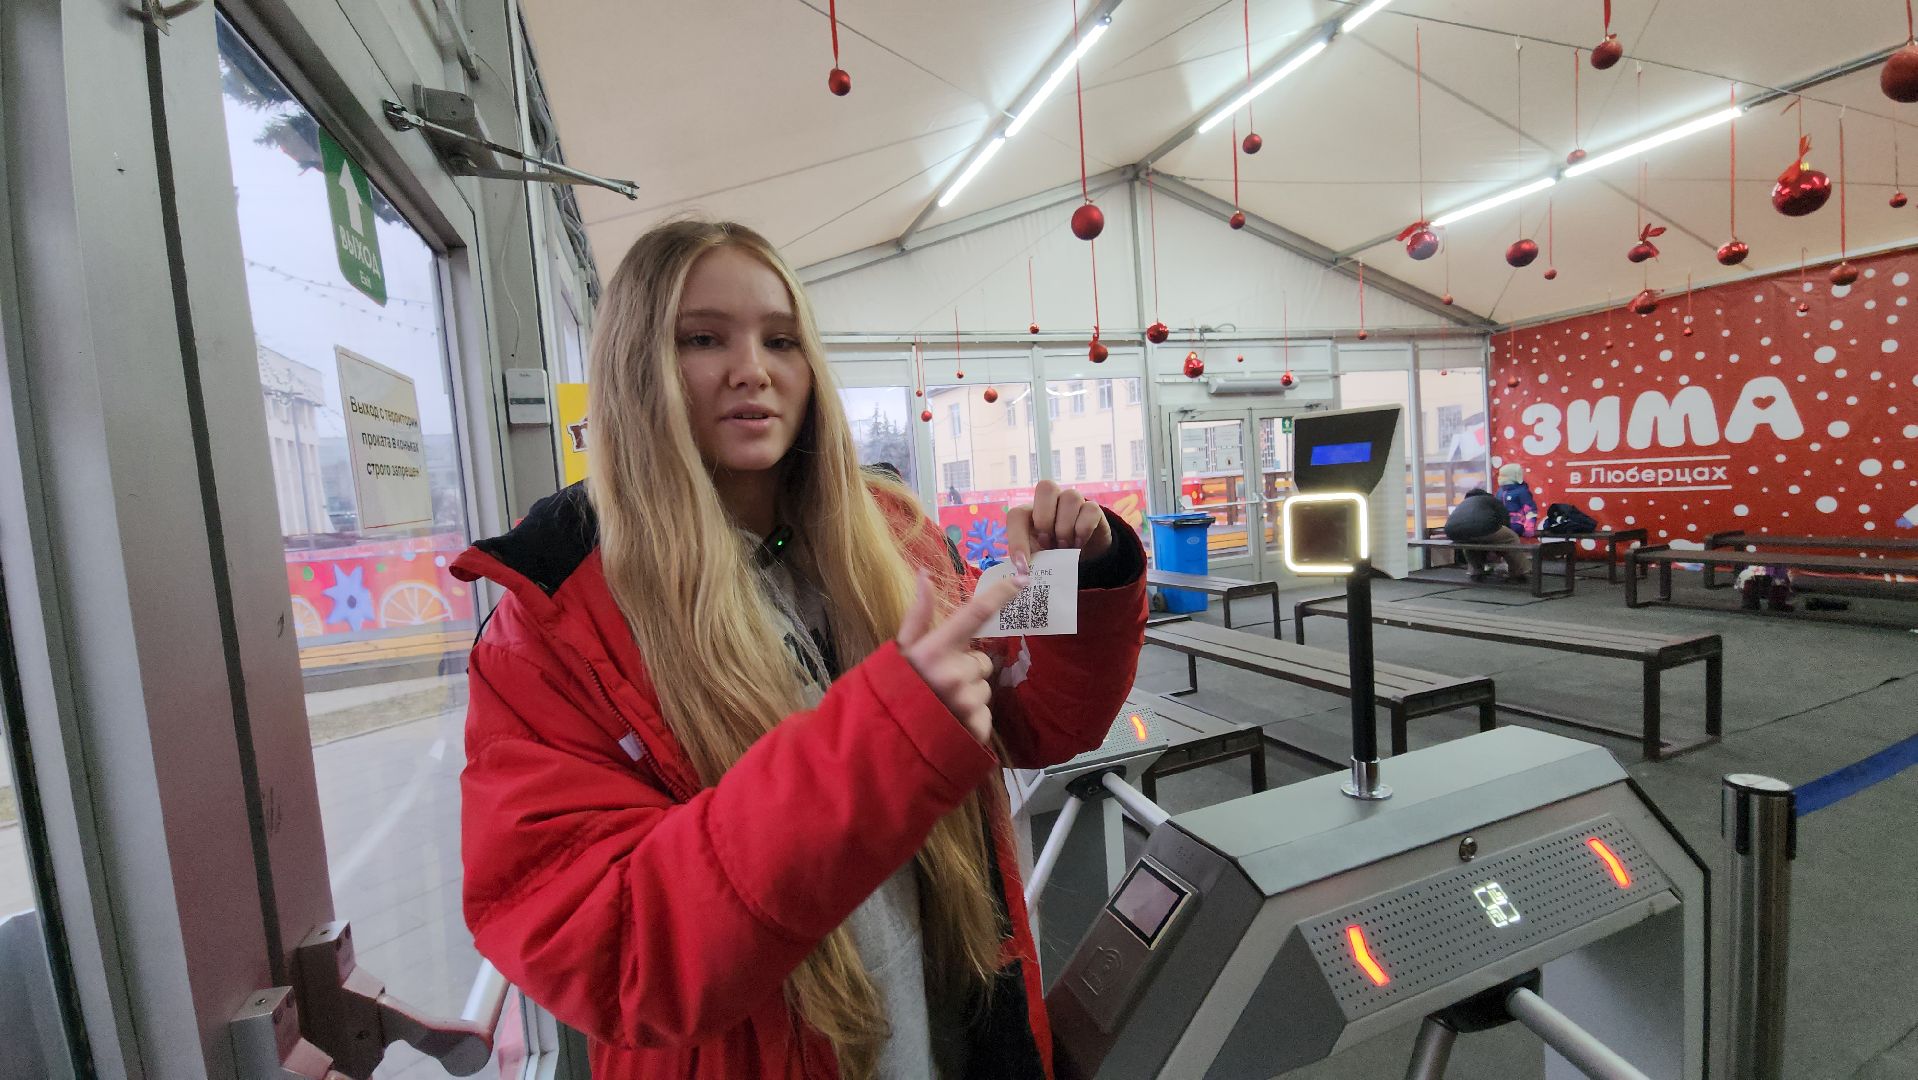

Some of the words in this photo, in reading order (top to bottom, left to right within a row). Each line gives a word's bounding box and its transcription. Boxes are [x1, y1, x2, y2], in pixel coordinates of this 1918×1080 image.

[339, 224, 381, 279] ВЫХОД
[350, 395, 379, 421] Выход
[384, 409, 418, 428] территории
[1521, 376, 1804, 456] ЗИМА
[361, 432, 391, 450] проката
[397, 439, 419, 453] коньках
[366, 462, 391, 480] строго
[1570, 471, 1581, 485] в
[1590, 465, 1728, 486] Люберцах
